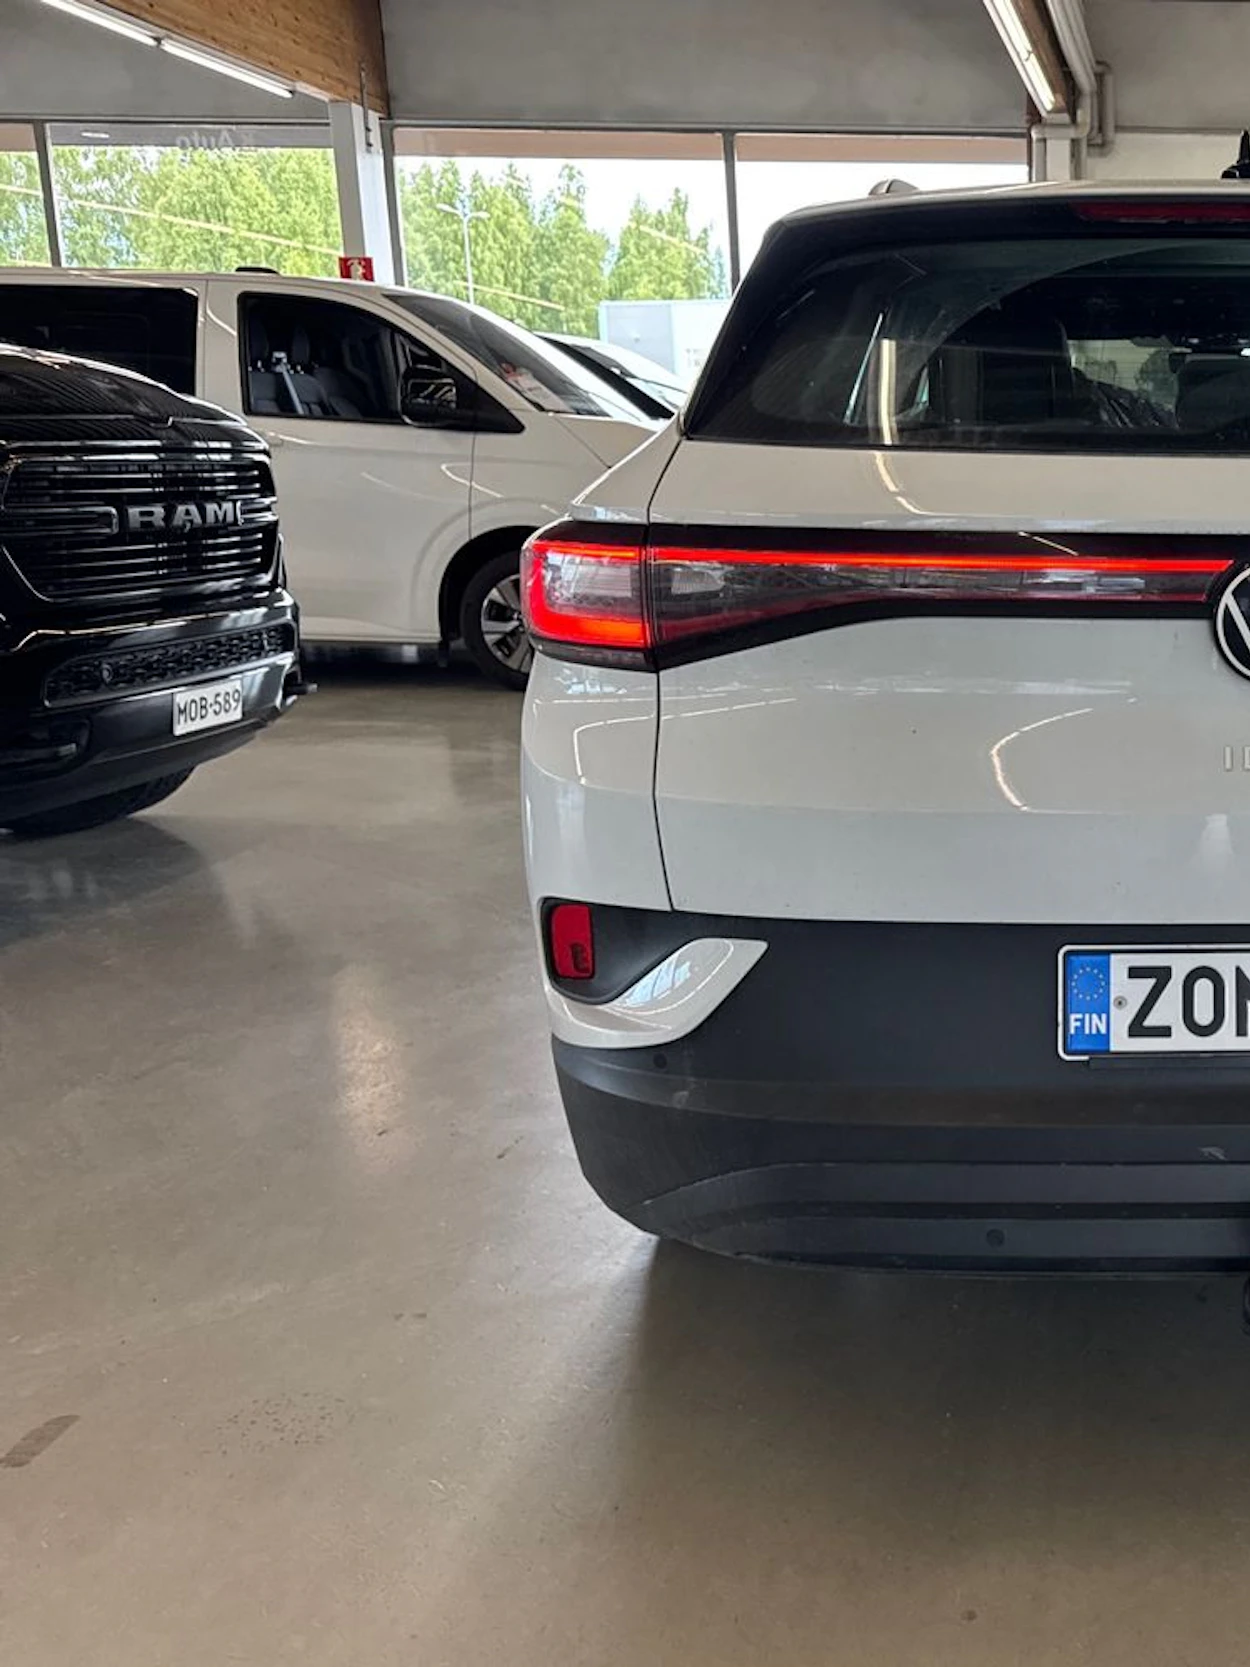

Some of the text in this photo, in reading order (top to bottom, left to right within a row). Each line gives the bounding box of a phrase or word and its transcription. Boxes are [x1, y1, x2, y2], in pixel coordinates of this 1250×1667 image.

[127, 502, 234, 528] RAM
[177, 688, 241, 725] MOB-589
[1069, 1013, 1107, 1035] FIN
